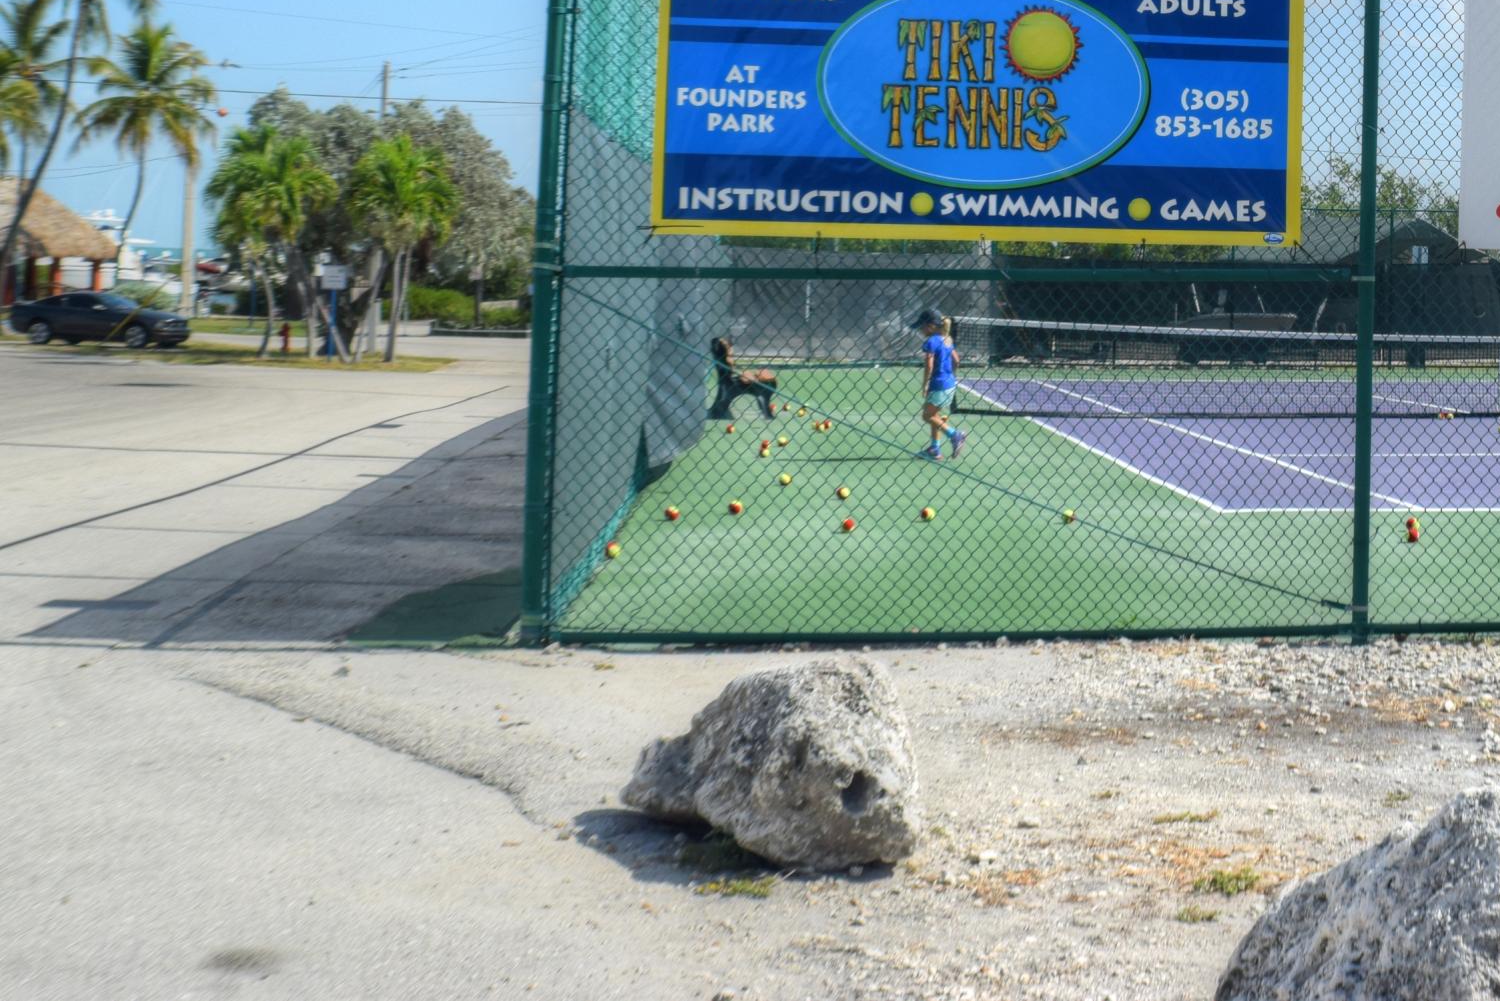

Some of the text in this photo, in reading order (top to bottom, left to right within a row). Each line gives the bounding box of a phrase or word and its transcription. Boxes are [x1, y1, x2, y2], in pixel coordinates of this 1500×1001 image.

[899, 18, 997, 83] TIKI
[724, 65, 761, 85] AT
[676, 87, 807, 111] FOUNDERS
[1180, 88, 1250, 113] (305)
[707, 112, 775, 134] PARK
[881, 83, 1068, 152] TENNIS
[1155, 115, 1274, 141] 853-1685
[678, 186, 1268, 223] INSTRUCTION SWIMMING GAMES
